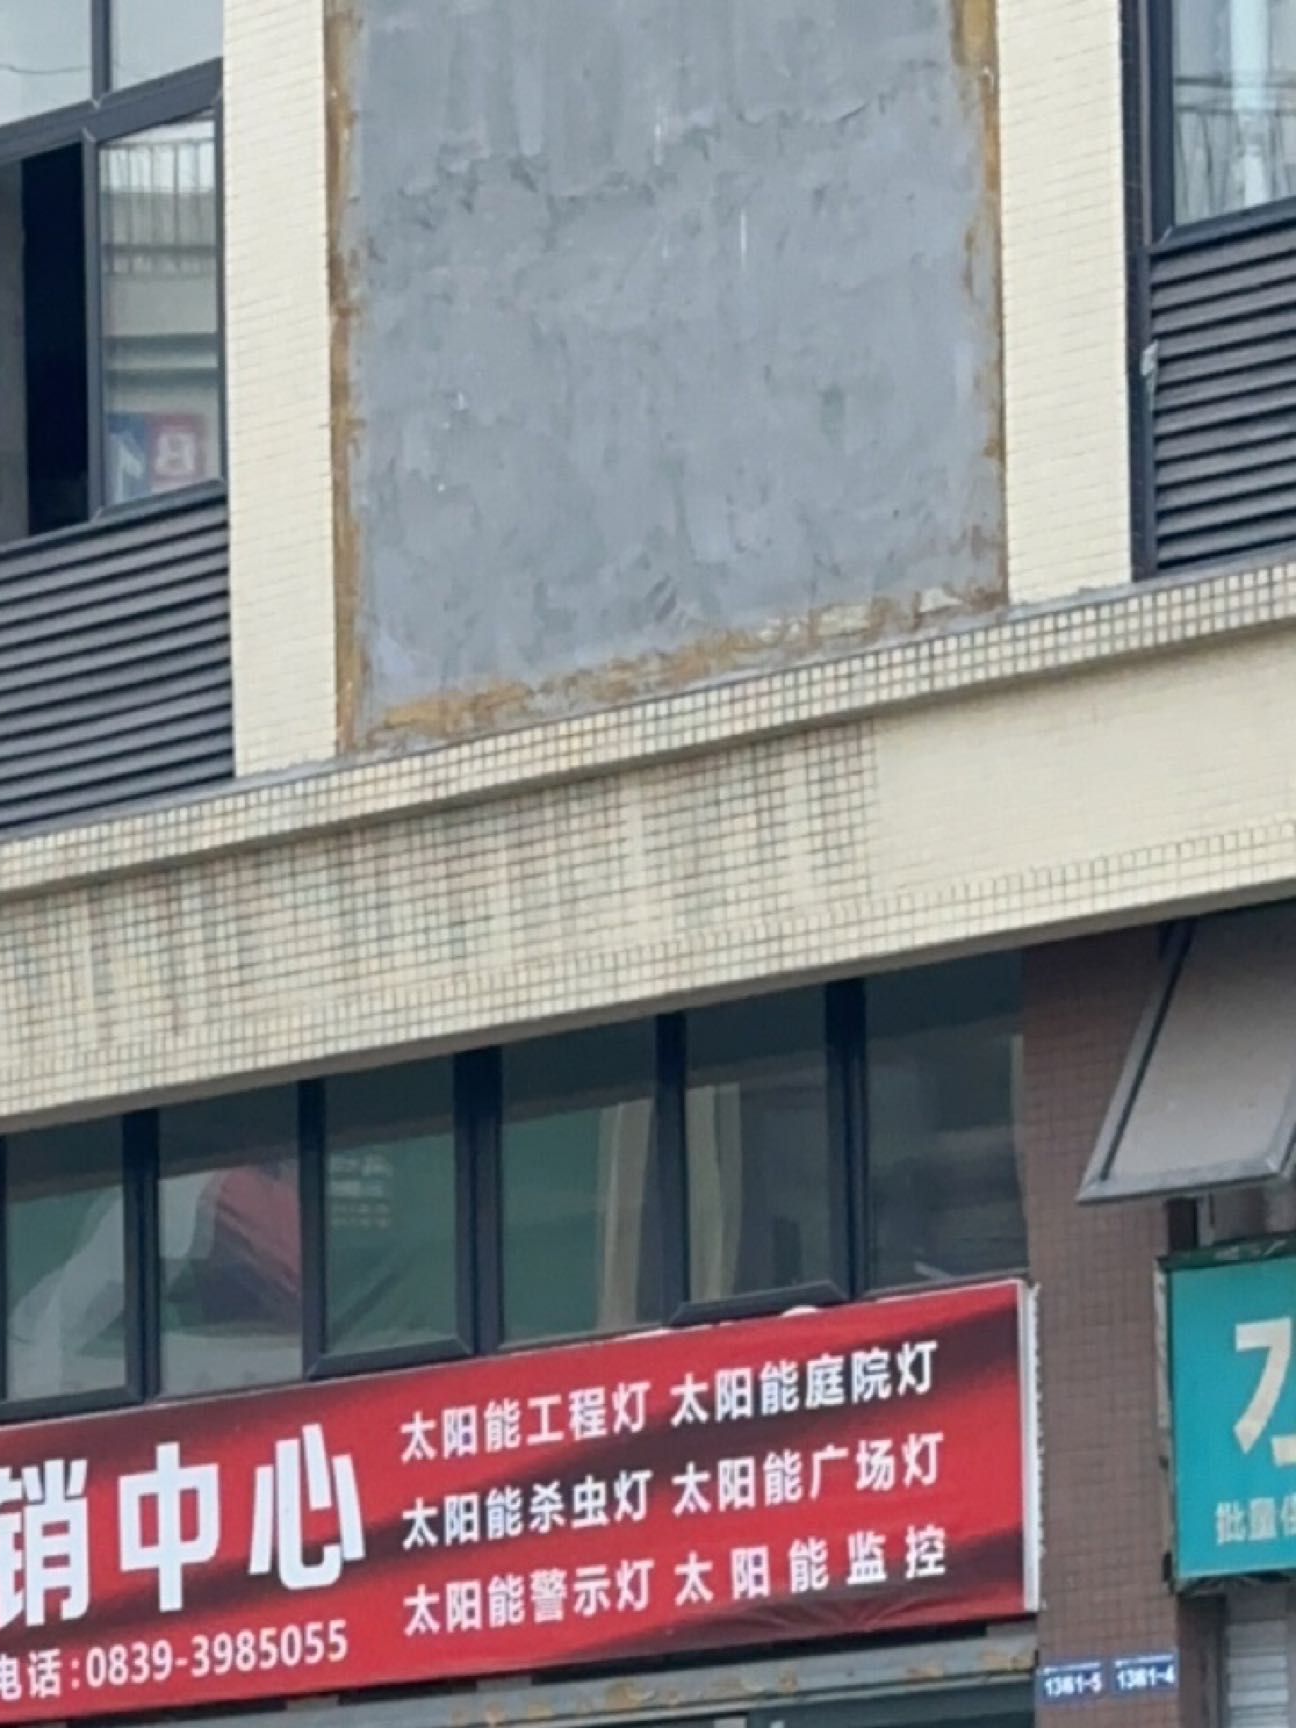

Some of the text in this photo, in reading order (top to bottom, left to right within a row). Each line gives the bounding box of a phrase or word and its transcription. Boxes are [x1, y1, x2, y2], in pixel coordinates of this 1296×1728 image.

[400, 1340, 939, 1463] 太阳能工程灯 太阳能庭院灯
[401, 1431, 944, 1550] 太阳能杀虫灯 太阳能广场灯
[403, 1559, 655, 1637] 太阳能警示灯
